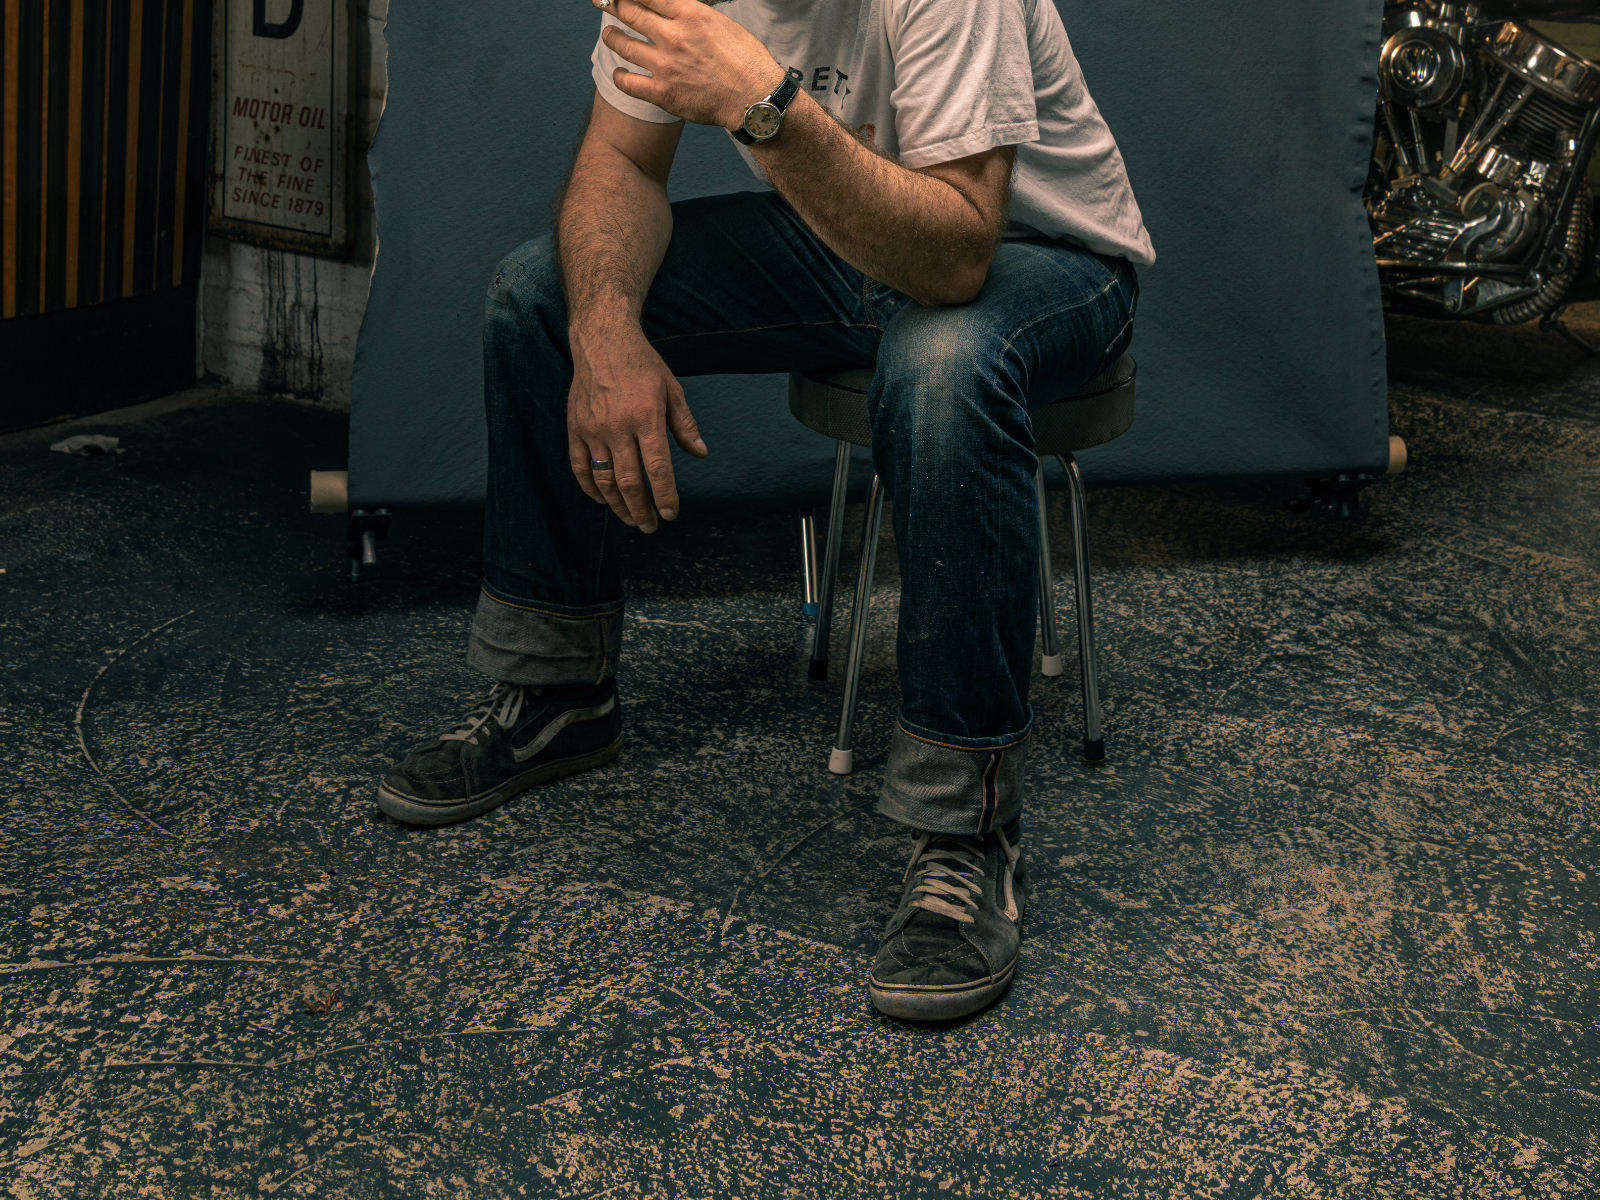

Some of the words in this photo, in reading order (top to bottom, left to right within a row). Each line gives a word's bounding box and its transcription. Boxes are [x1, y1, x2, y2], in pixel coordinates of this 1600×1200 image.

[233, 96, 293, 125] MOTOR
[299, 106, 326, 130] OIL
[234, 145, 292, 169] FINEST
[300, 156, 324, 173] OF
[239, 167, 268, 186] THE
[277, 174, 315, 194] FINE
[232, 187, 281, 209] SINCE
[287, 197, 324, 217] 1879
